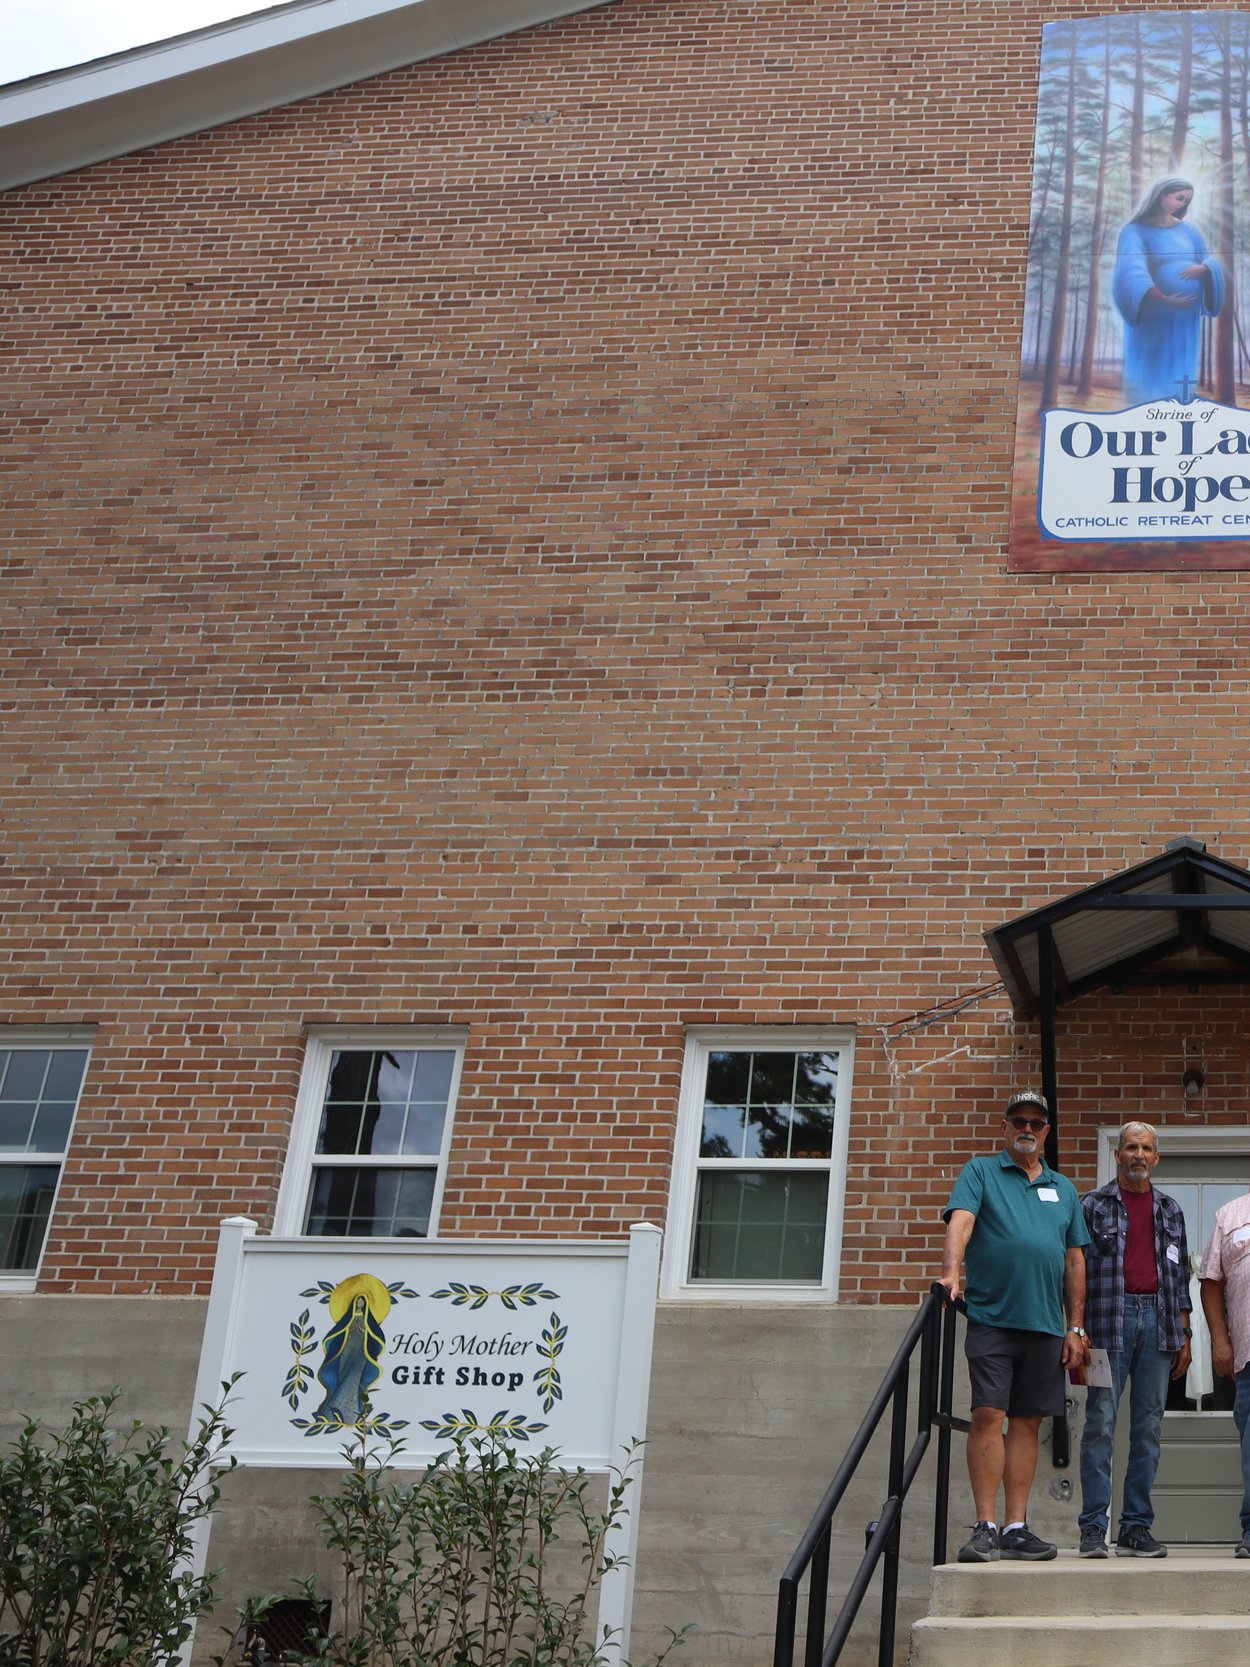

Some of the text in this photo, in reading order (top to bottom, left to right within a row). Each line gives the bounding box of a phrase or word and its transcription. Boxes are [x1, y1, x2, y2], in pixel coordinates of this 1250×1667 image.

[1145, 407, 1218, 422] Shrine of
[1060, 421, 1167, 459] Our
[1178, 456, 1202, 476] of
[1055, 516, 1129, 529] CATHOLIC
[1137, 514, 1214, 526] RETREAT
[389, 1331, 533, 1362] Holy Mother
[392, 1366, 524, 1392] Gift Shop
